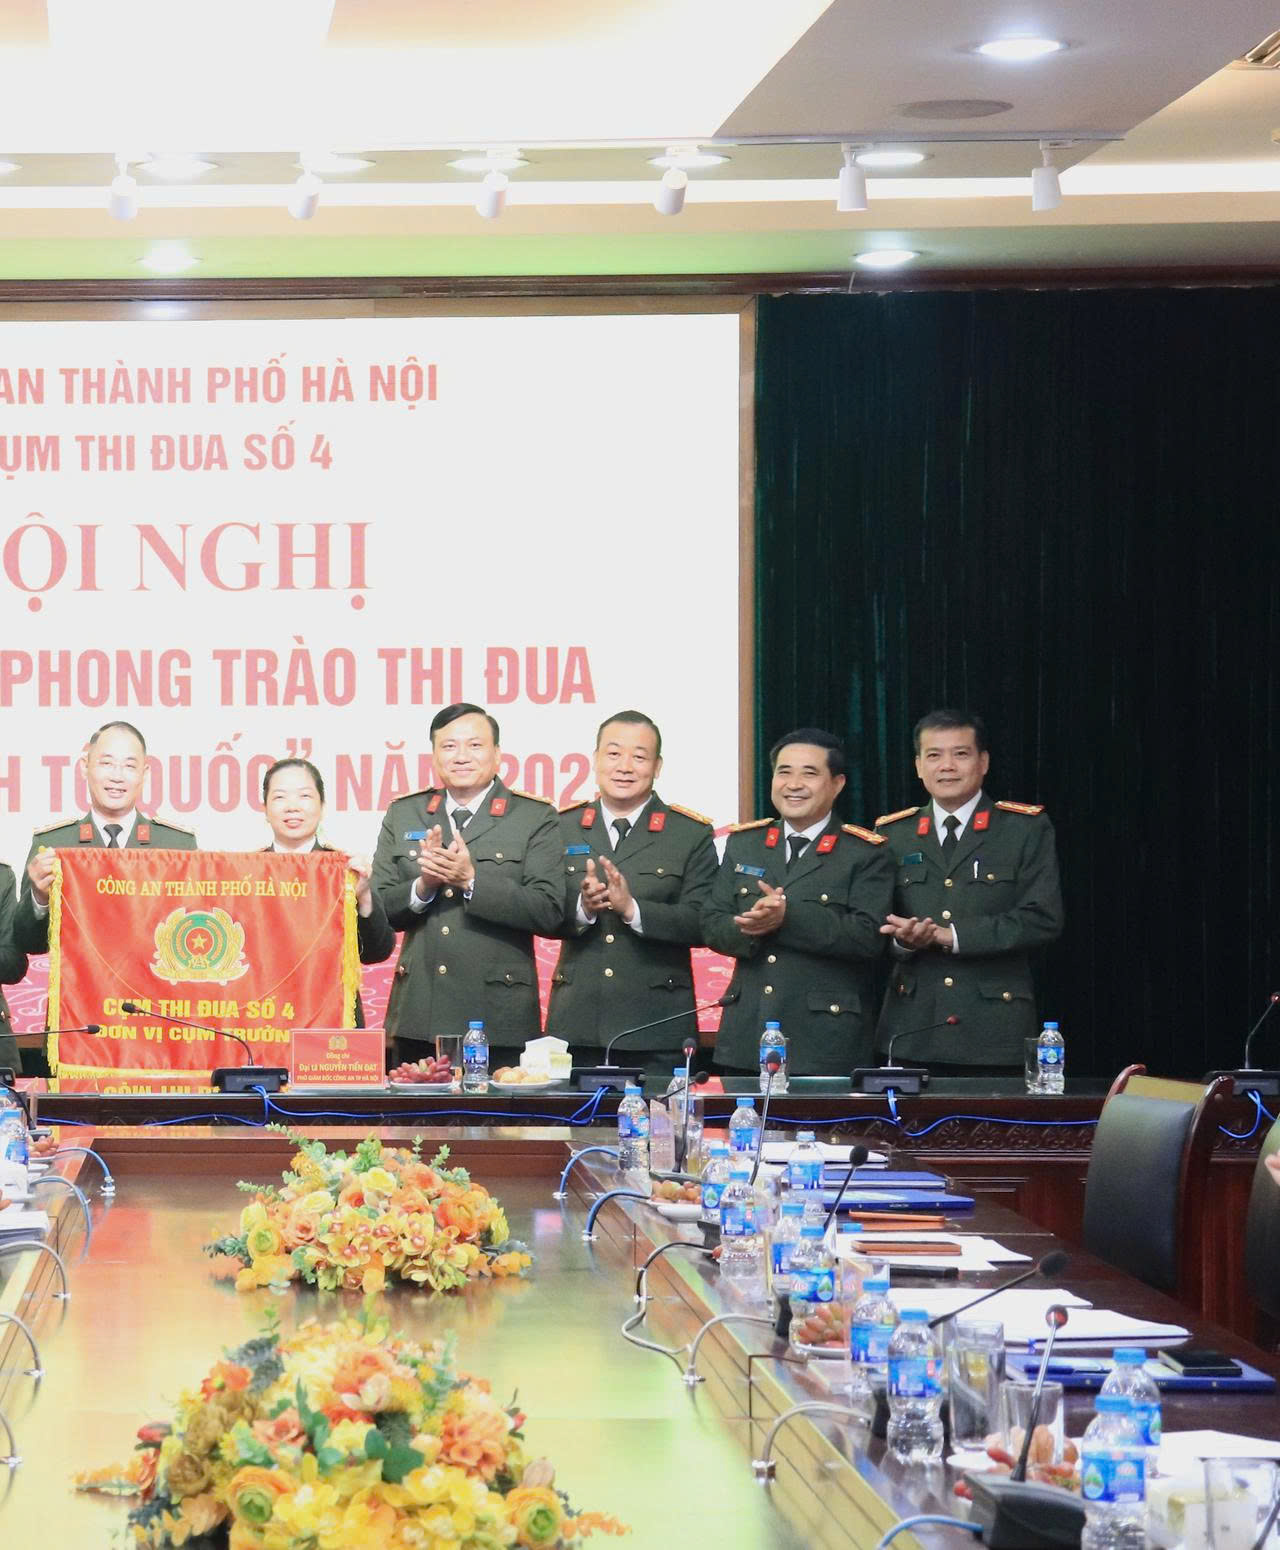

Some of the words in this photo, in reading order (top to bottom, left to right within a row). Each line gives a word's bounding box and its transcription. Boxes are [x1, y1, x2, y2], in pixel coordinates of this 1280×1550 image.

[60, 357, 190, 404] THÀNH
[207, 353, 285, 403] PHỐ
[303, 357, 353, 402] HÀ
[370, 356, 437, 410] NỘI
[75, 435, 135, 471] THI
[150, 435, 228, 470] ĐUA
[244, 419, 294, 470] SỐ
[311, 434, 332, 469] 4
[132, 521, 374, 610] NGHỊ
[0, 650, 191, 708] PHONG
[212, 636, 356, 706] TRÀO
[378, 647, 463, 706] THI
[483, 646, 596, 706] ĐUA
[497, 752, 602, 812] 202
[96, 874, 136, 897] CÔNG
[140, 879, 163, 897] AN
[165, 876, 217, 897] THÀNH
[220, 873, 253, 896] PHỐ
[255, 876, 276, 897] HÀ
[279, 877, 308, 900] NỘI
[96, 1023, 137, 1041] ĐƠN
[143, 1026, 163, 1043] VỊ
[169, 1026, 217, 1044] CỤM
[224, 1024, 290, 1043] TRƯỞN
[103, 998, 152, 1020] CỤM
[158, 999, 191, 1018] THI
[197, 999, 240, 1018] ĐUA
[246, 995, 277, 1020] SỐ
[281, 1001, 295, 1020] 4
